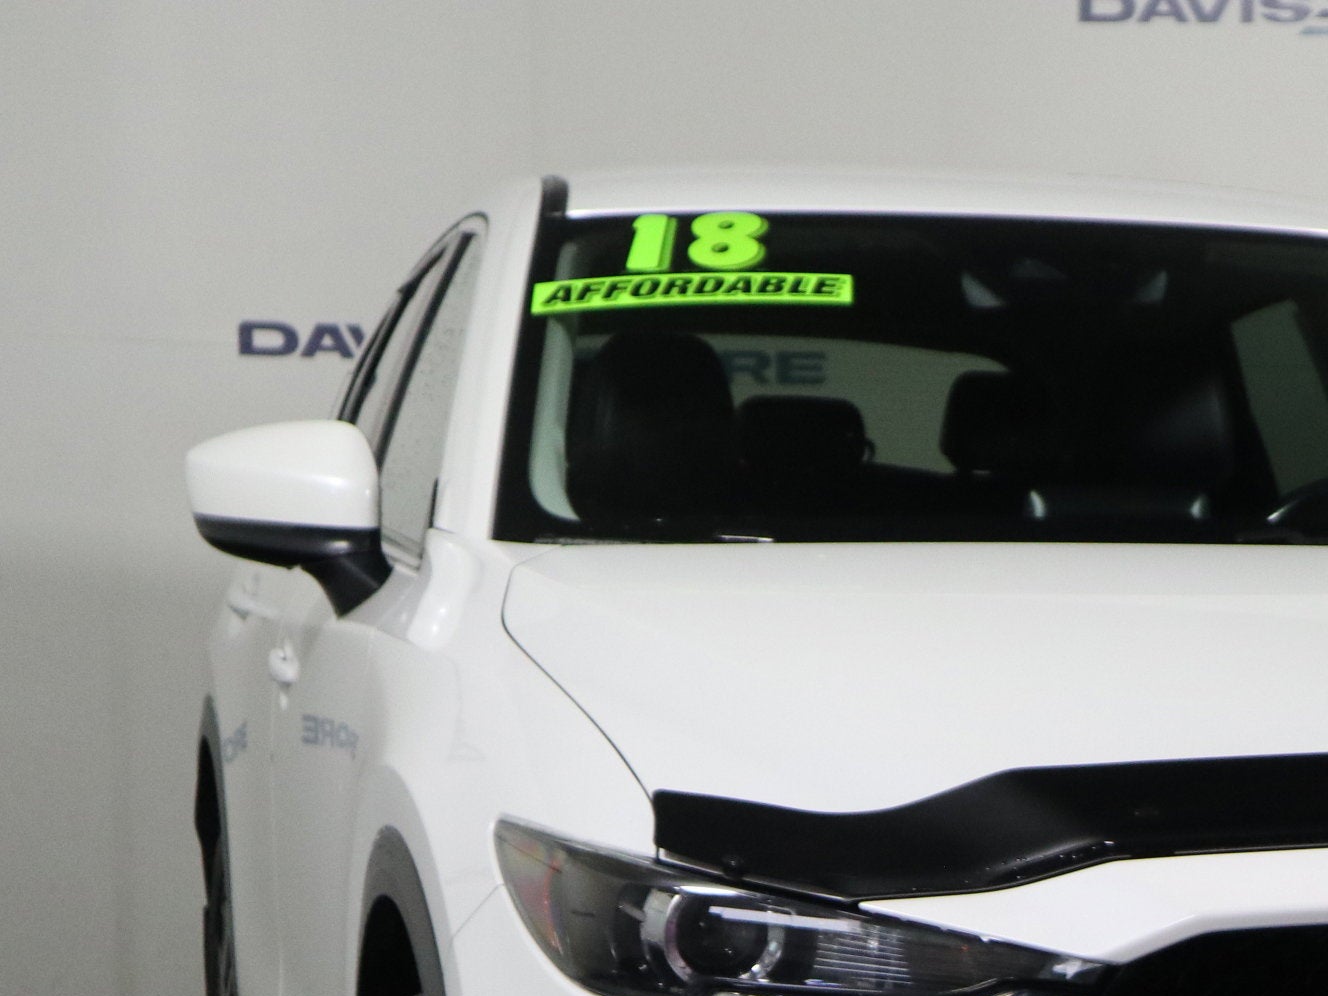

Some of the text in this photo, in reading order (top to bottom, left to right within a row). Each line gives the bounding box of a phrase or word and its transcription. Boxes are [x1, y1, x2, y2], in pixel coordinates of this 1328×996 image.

[1079, 0, 1310, 23] DAVIS
[626, 212, 768, 272] 18
[543, 276, 842, 304] AFFORDABLE
